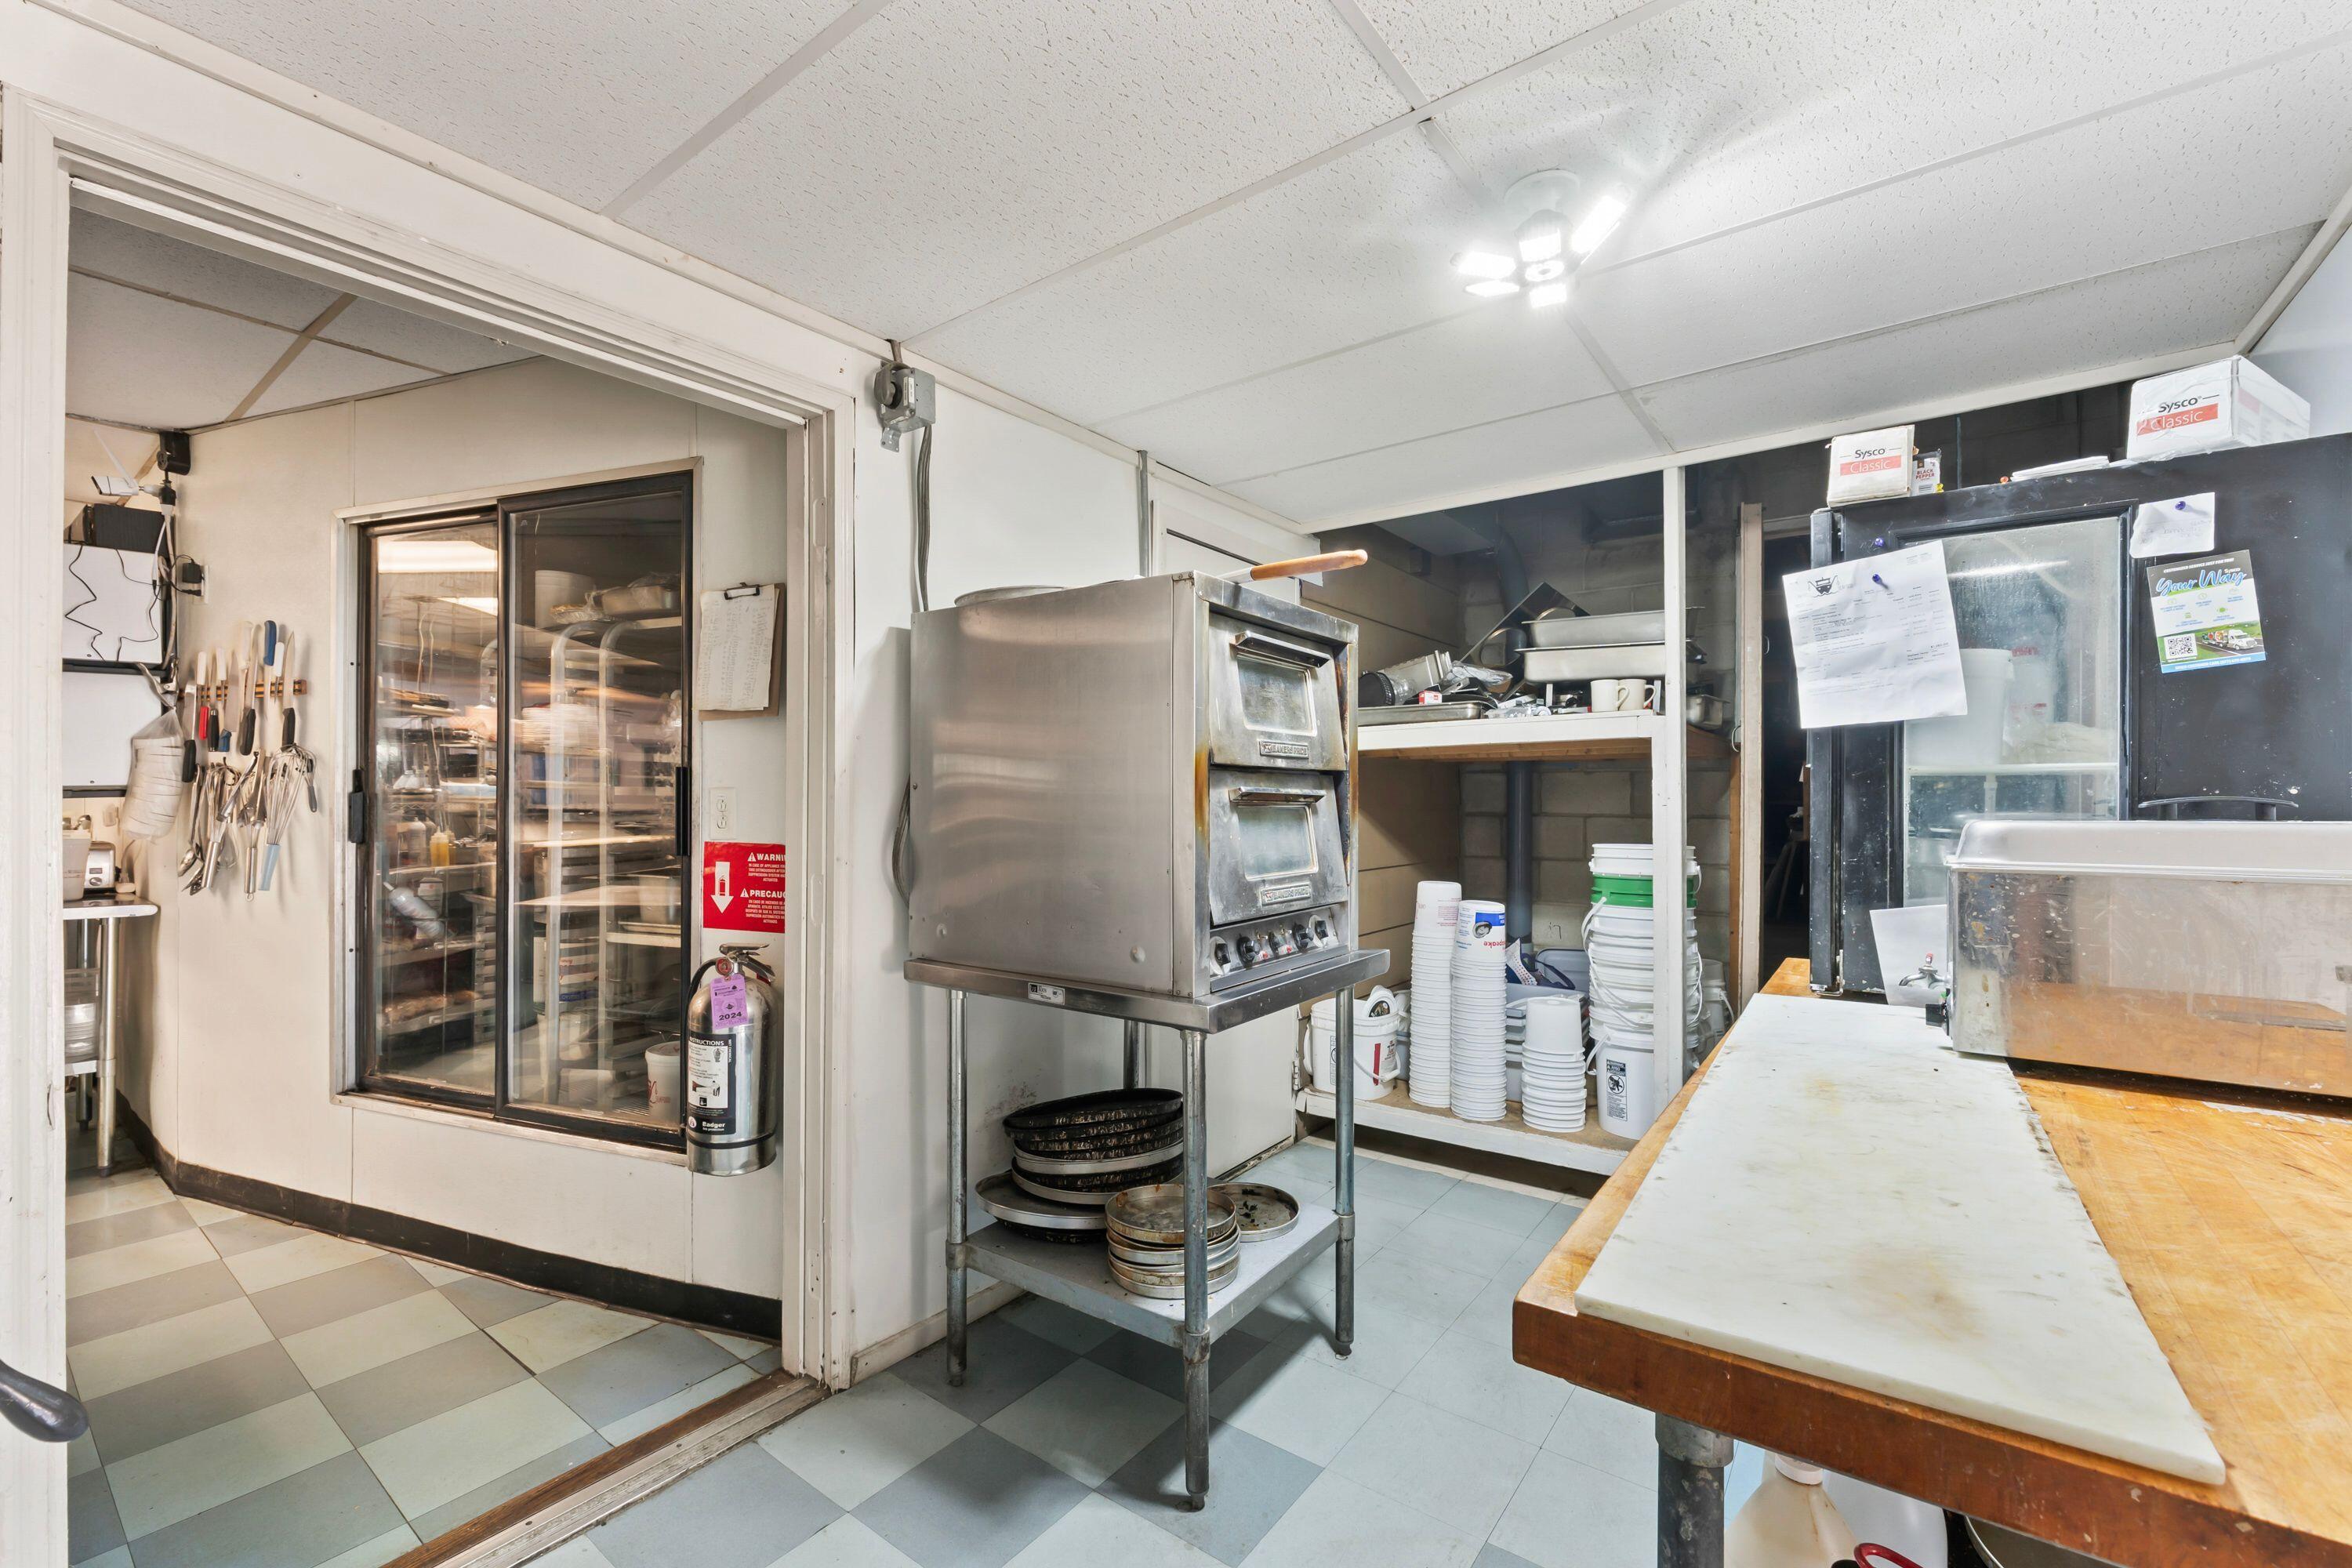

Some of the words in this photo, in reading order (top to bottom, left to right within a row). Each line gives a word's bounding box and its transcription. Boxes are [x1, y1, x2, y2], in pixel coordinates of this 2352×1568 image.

[2158, 397, 2198, 414] Sysco
[2151, 410, 2203, 431] Classic
[1855, 448, 1886, 459] Sysco
[1850, 459, 1891, 474] Classic
[2156, 577, 2198, 597] Your
[2199, 569, 2247, 589] Way
[719, 1011, 742, 1021] 2024
